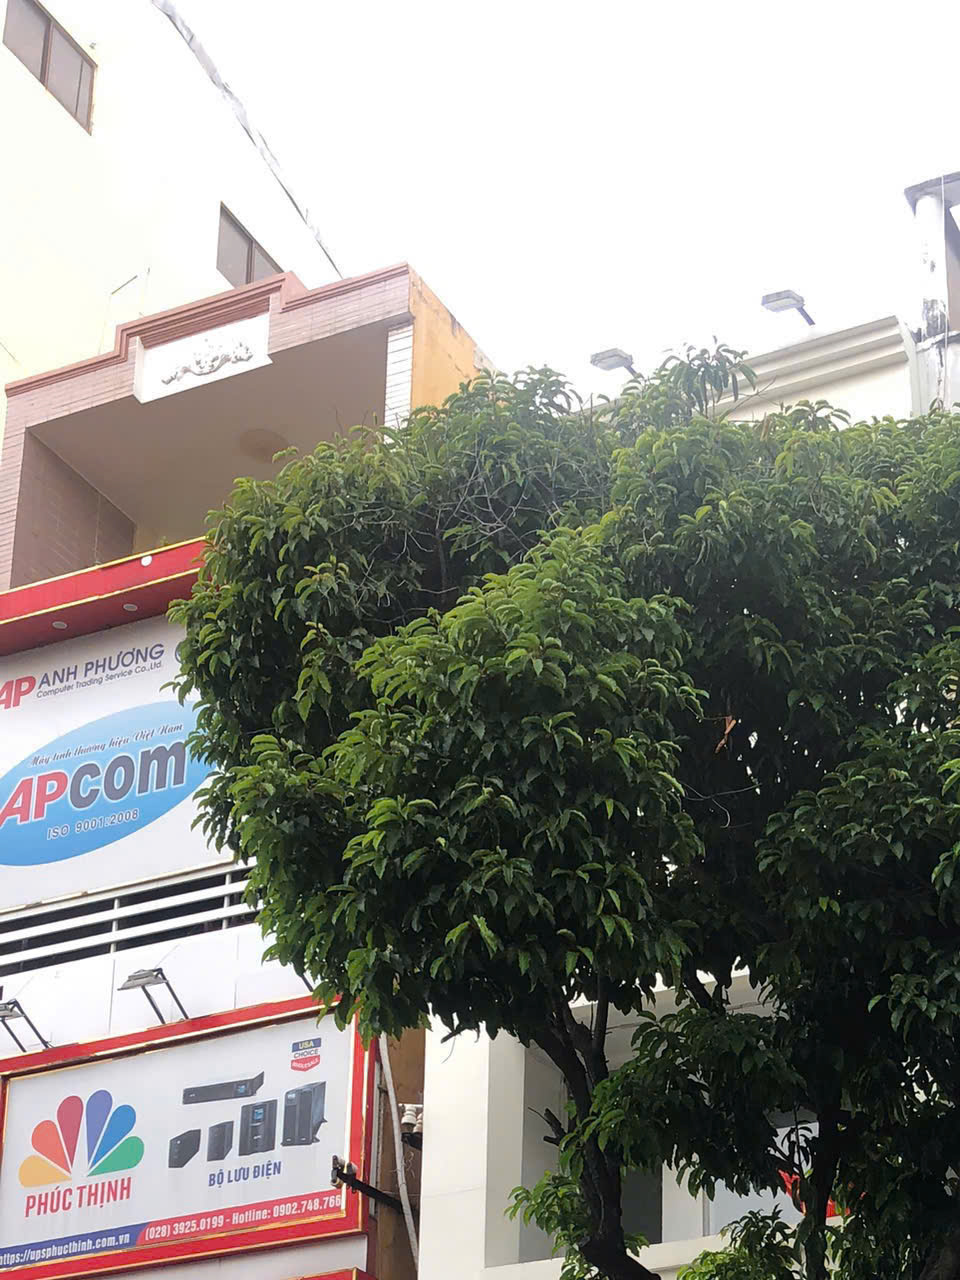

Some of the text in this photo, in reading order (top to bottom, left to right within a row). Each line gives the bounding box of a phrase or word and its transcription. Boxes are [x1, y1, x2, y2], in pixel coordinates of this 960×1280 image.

[38, 643, 165, 689] ANH PHƯƠNG
[36, 683, 74, 698] Computer
[75, 677, 104, 689] Trading
[105, 669, 133, 682] Service
[47, 808, 140, 840] ISO 9001:2008
[298, 1041, 314, 1050] USA
[208, 1160, 282, 1188] BỘ LƯU ĐIỆN
[24, 1176, 132, 1218] PHÚC THỊNH
[144, 1223, 171, 1240] (028)
[172, 1215, 224, 1236] 3925.0199
[232, 1209, 271, 1225] Hotline:
